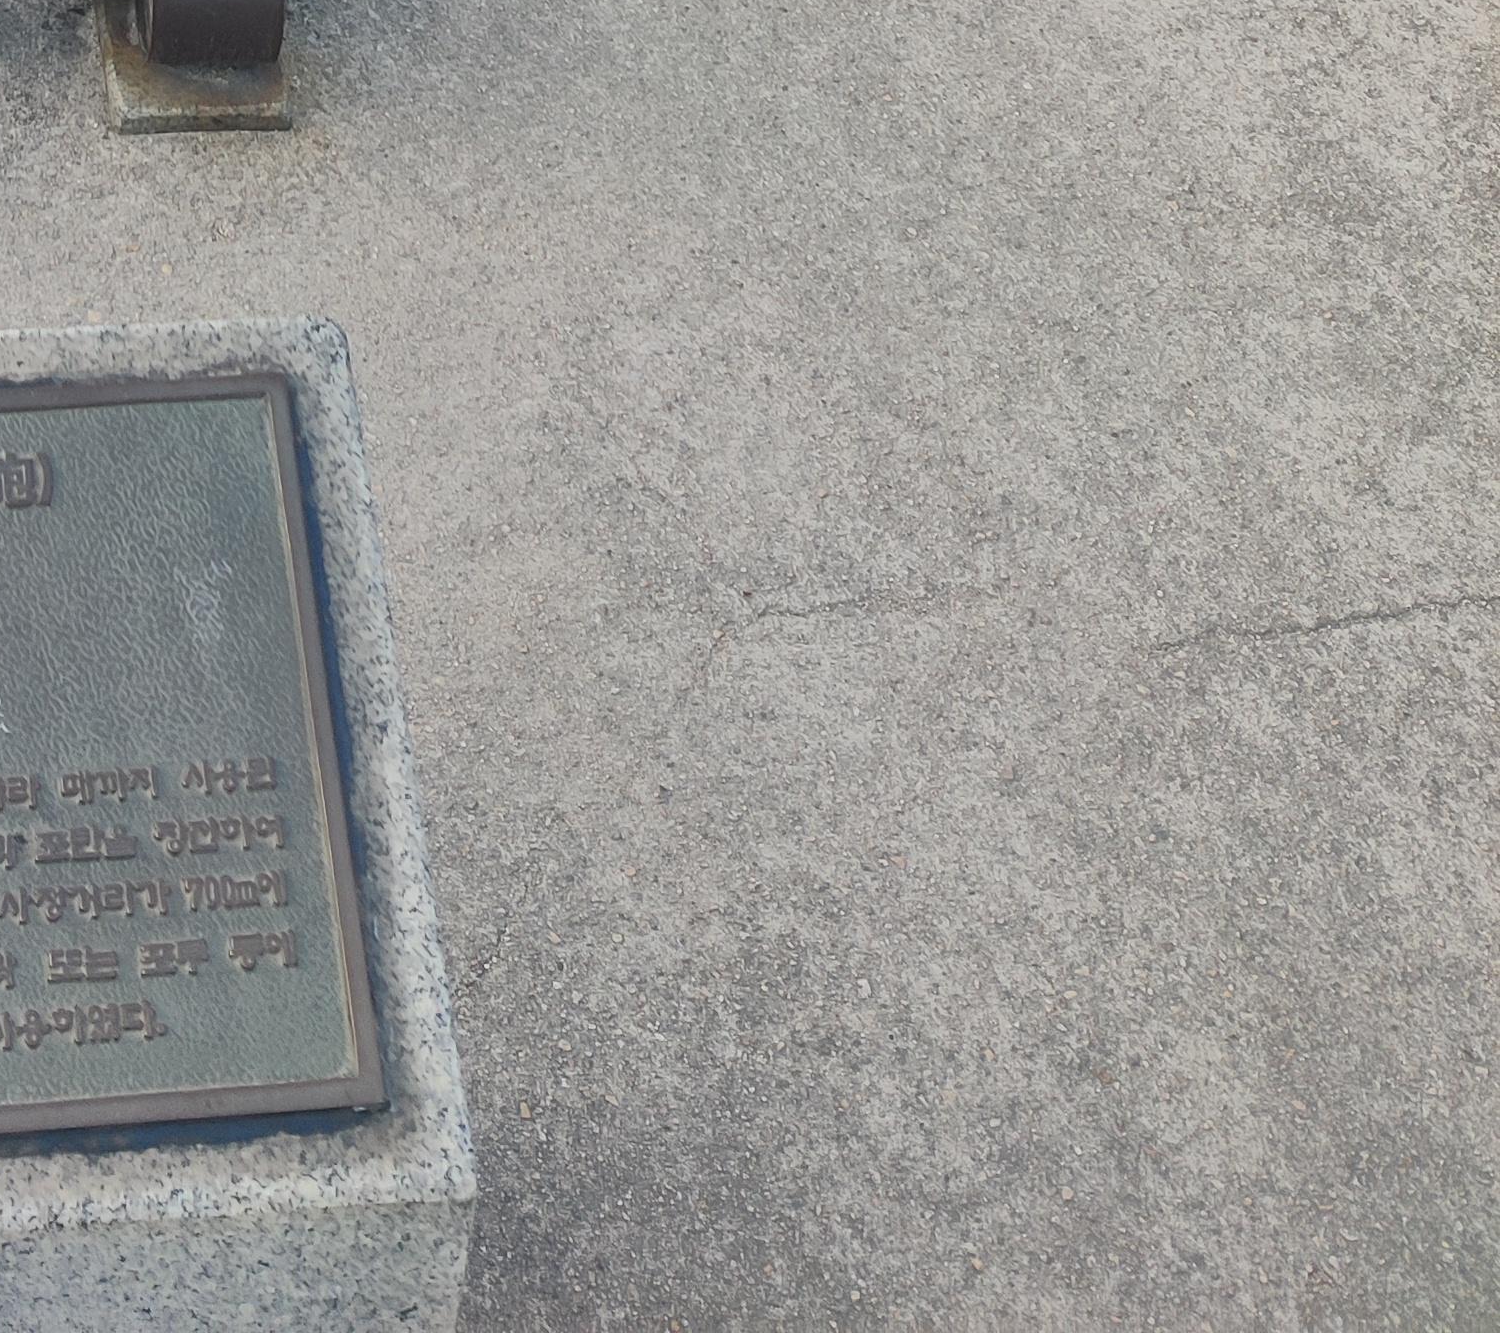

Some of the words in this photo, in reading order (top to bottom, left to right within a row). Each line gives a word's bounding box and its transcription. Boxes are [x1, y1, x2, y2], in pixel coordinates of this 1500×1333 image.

[181, 755, 277, 795] 사용된
[34, 826, 139, 863] 포탄을
[153, 814, 285, 855] 장전하여
[47, 945, 119, 984] 또는
[228, 929, 299, 971] 등에
